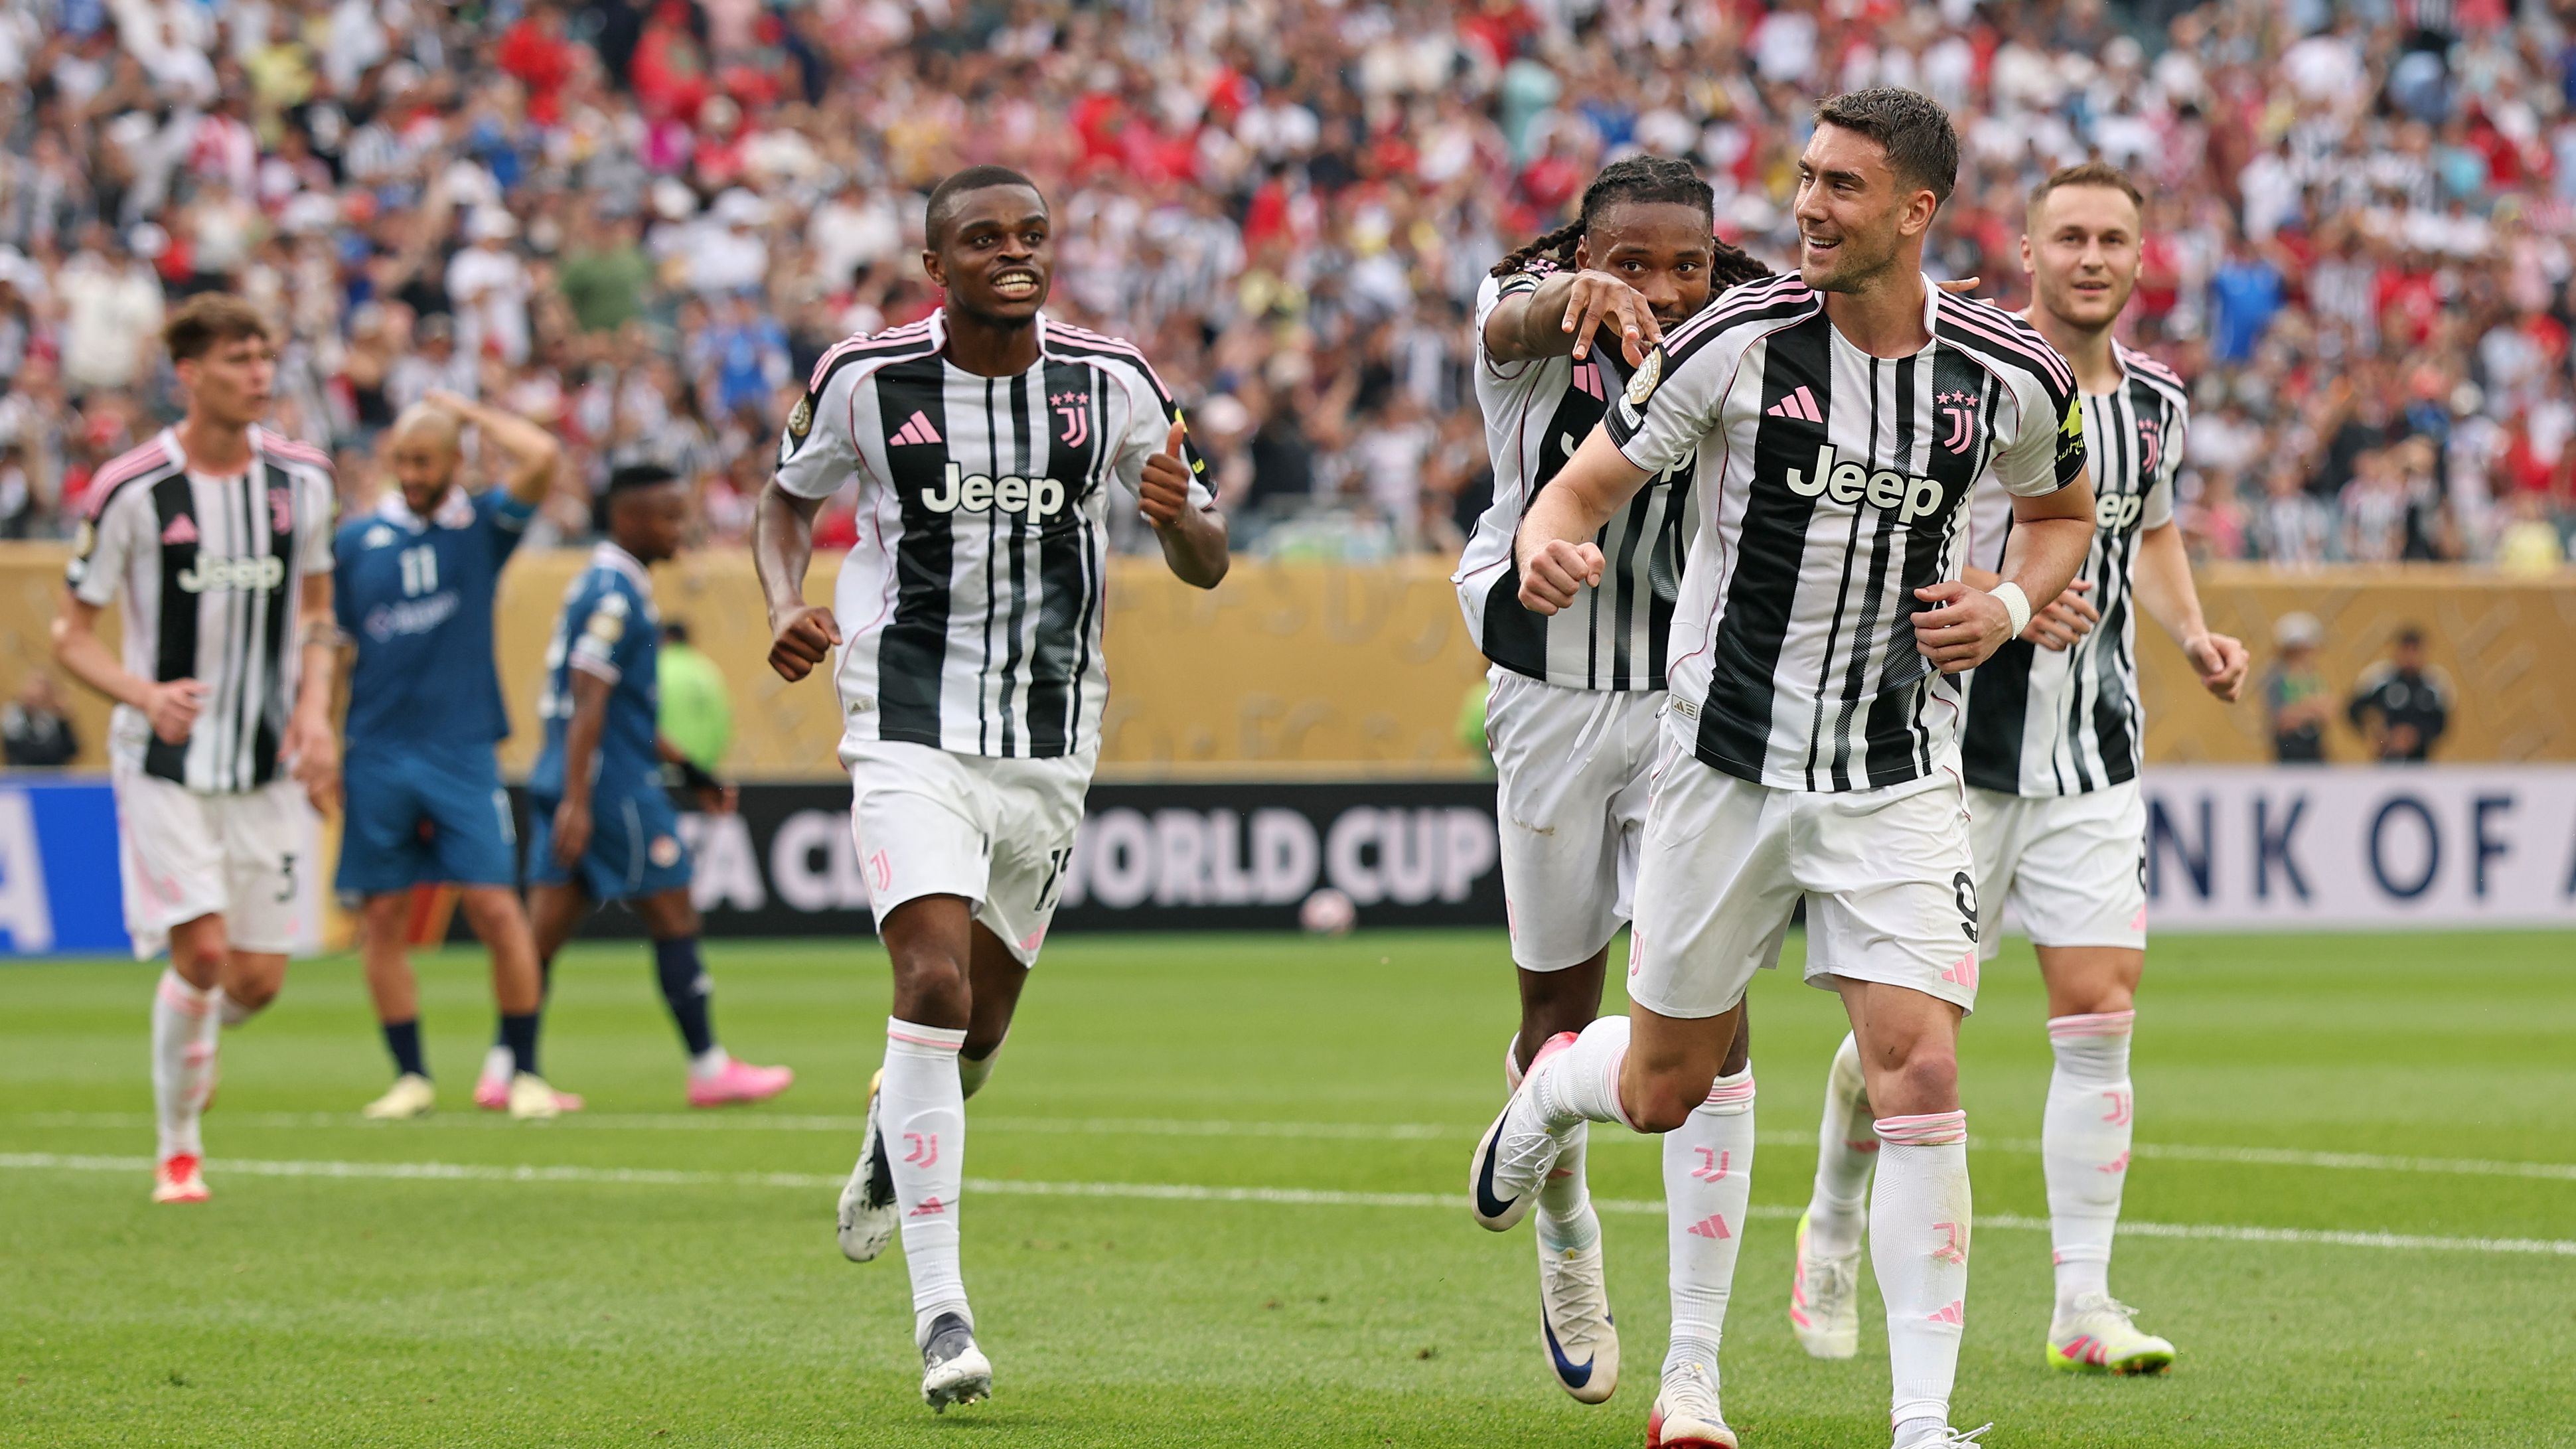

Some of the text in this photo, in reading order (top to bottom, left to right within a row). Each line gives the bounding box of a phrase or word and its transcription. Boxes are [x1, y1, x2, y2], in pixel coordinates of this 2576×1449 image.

[921, 463, 1065, 524] Jeep
[1787, 445, 1943, 524] Jeep
[2095, 493, 2142, 536] ep
[176, 549, 285, 597] Jeep
[400, 543, 439, 597] 11
[1328, 804, 1497, 905] CUP
[2146, 795, 2311, 899] NK
[2366, 793, 2514, 901] OF
